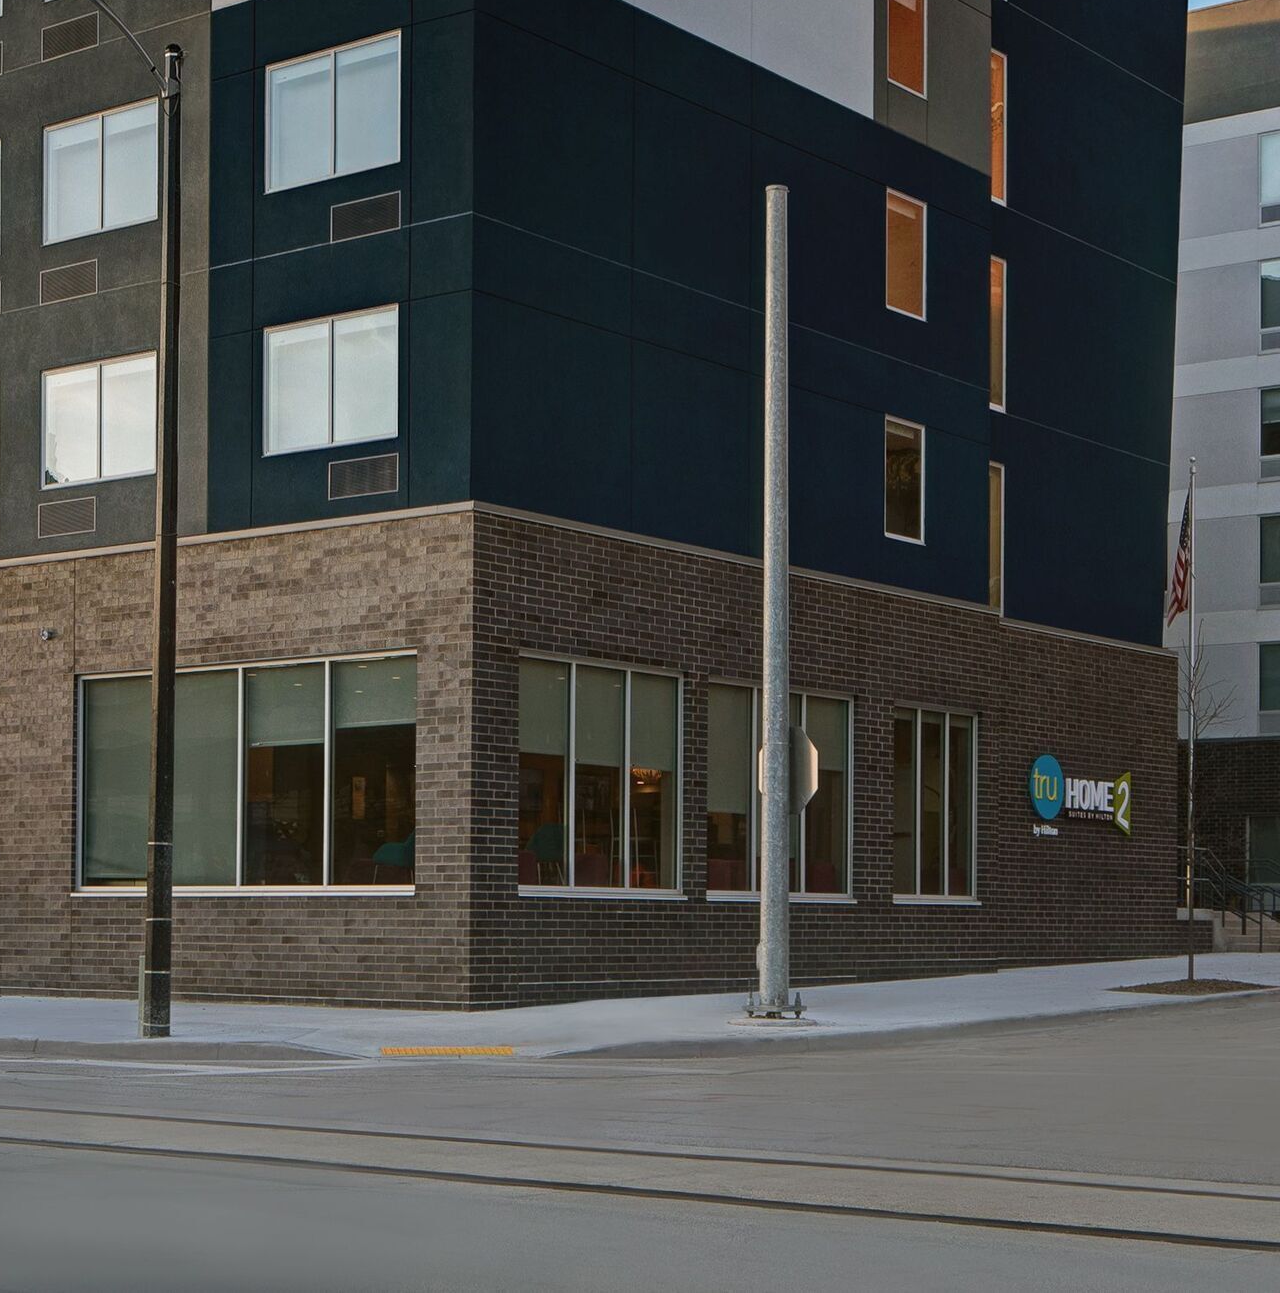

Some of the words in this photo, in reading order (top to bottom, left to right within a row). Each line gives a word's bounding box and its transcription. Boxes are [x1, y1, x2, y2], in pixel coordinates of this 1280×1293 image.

[1033, 767, 1058, 801] tru
[1068, 810, 1087, 819] SUITES
[1033, 823, 1041, 837] by
